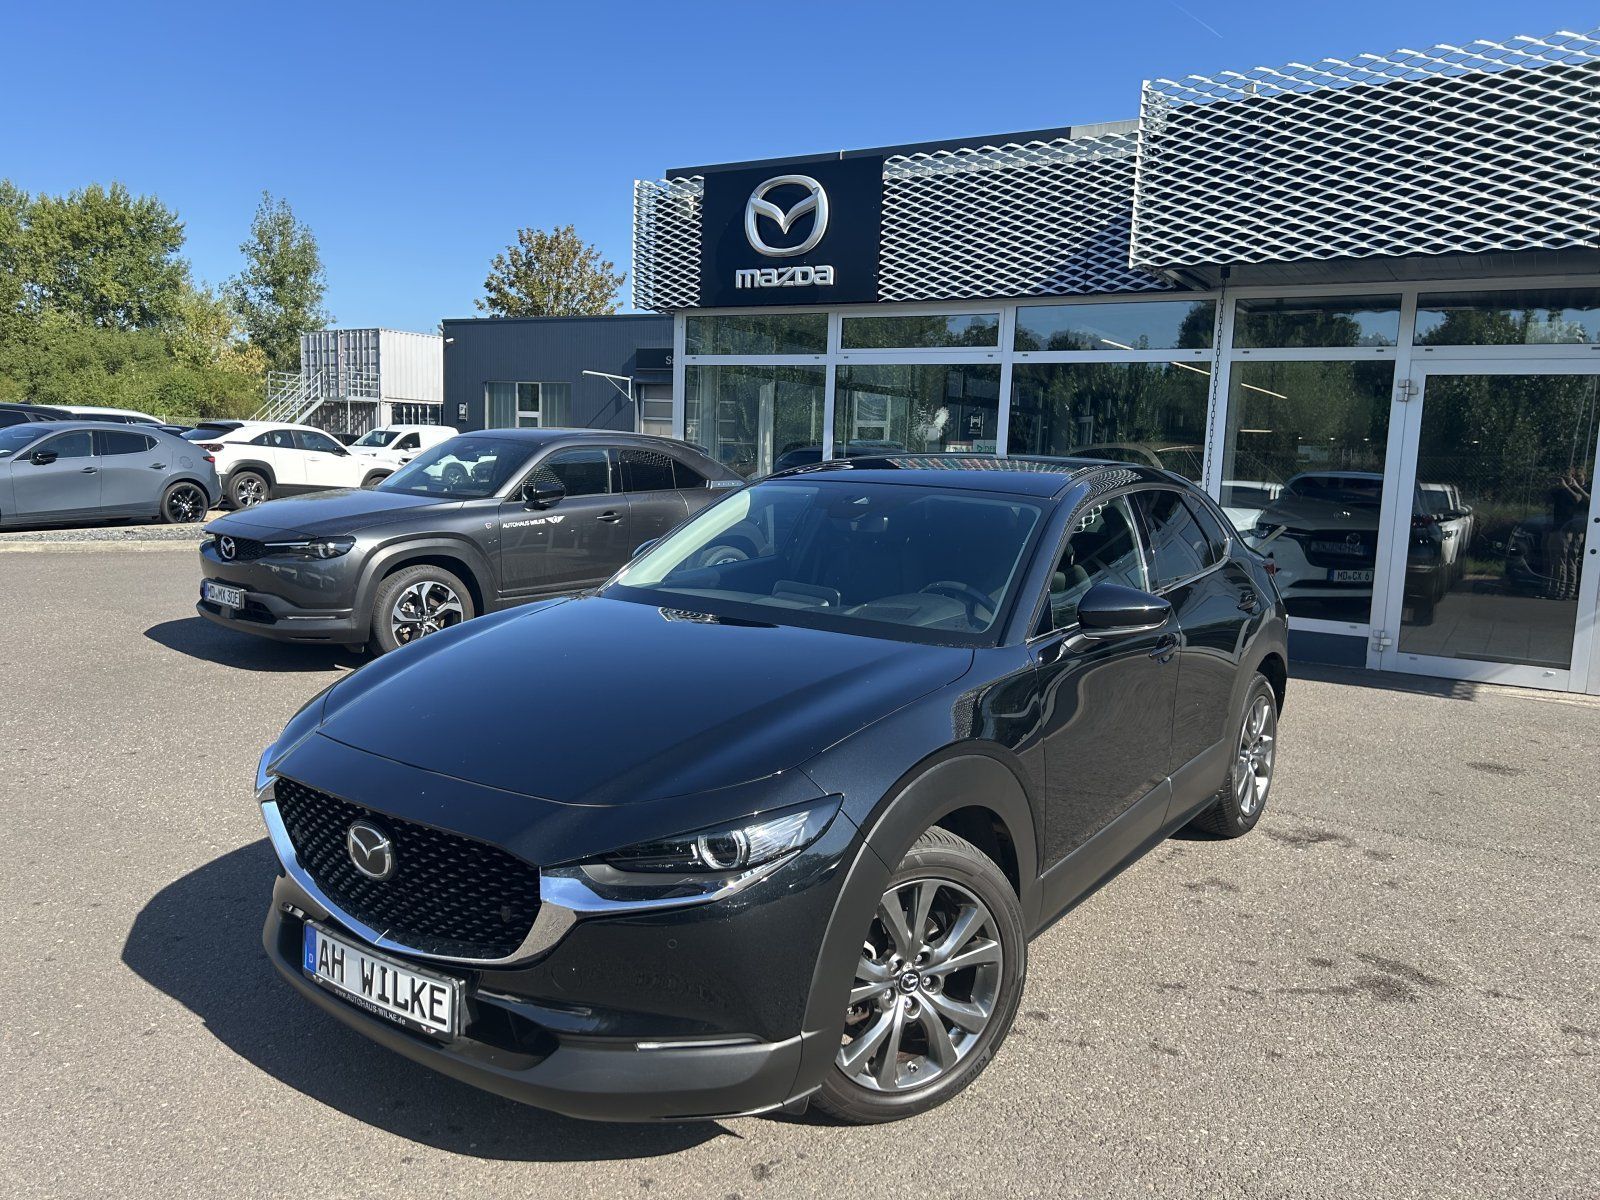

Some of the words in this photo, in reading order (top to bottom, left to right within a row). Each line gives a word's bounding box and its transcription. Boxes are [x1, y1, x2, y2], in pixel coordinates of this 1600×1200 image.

[665, 355, 674, 365] S
[502, 520, 530, 529] AUTOHAUS
[1352, 571, 1362, 580] CX
[318, 938, 345, 983] AH
[360, 957, 447, 1026] WILKE
[335, 988, 406, 1025] www.AUTOHAUS-WILKE.de
